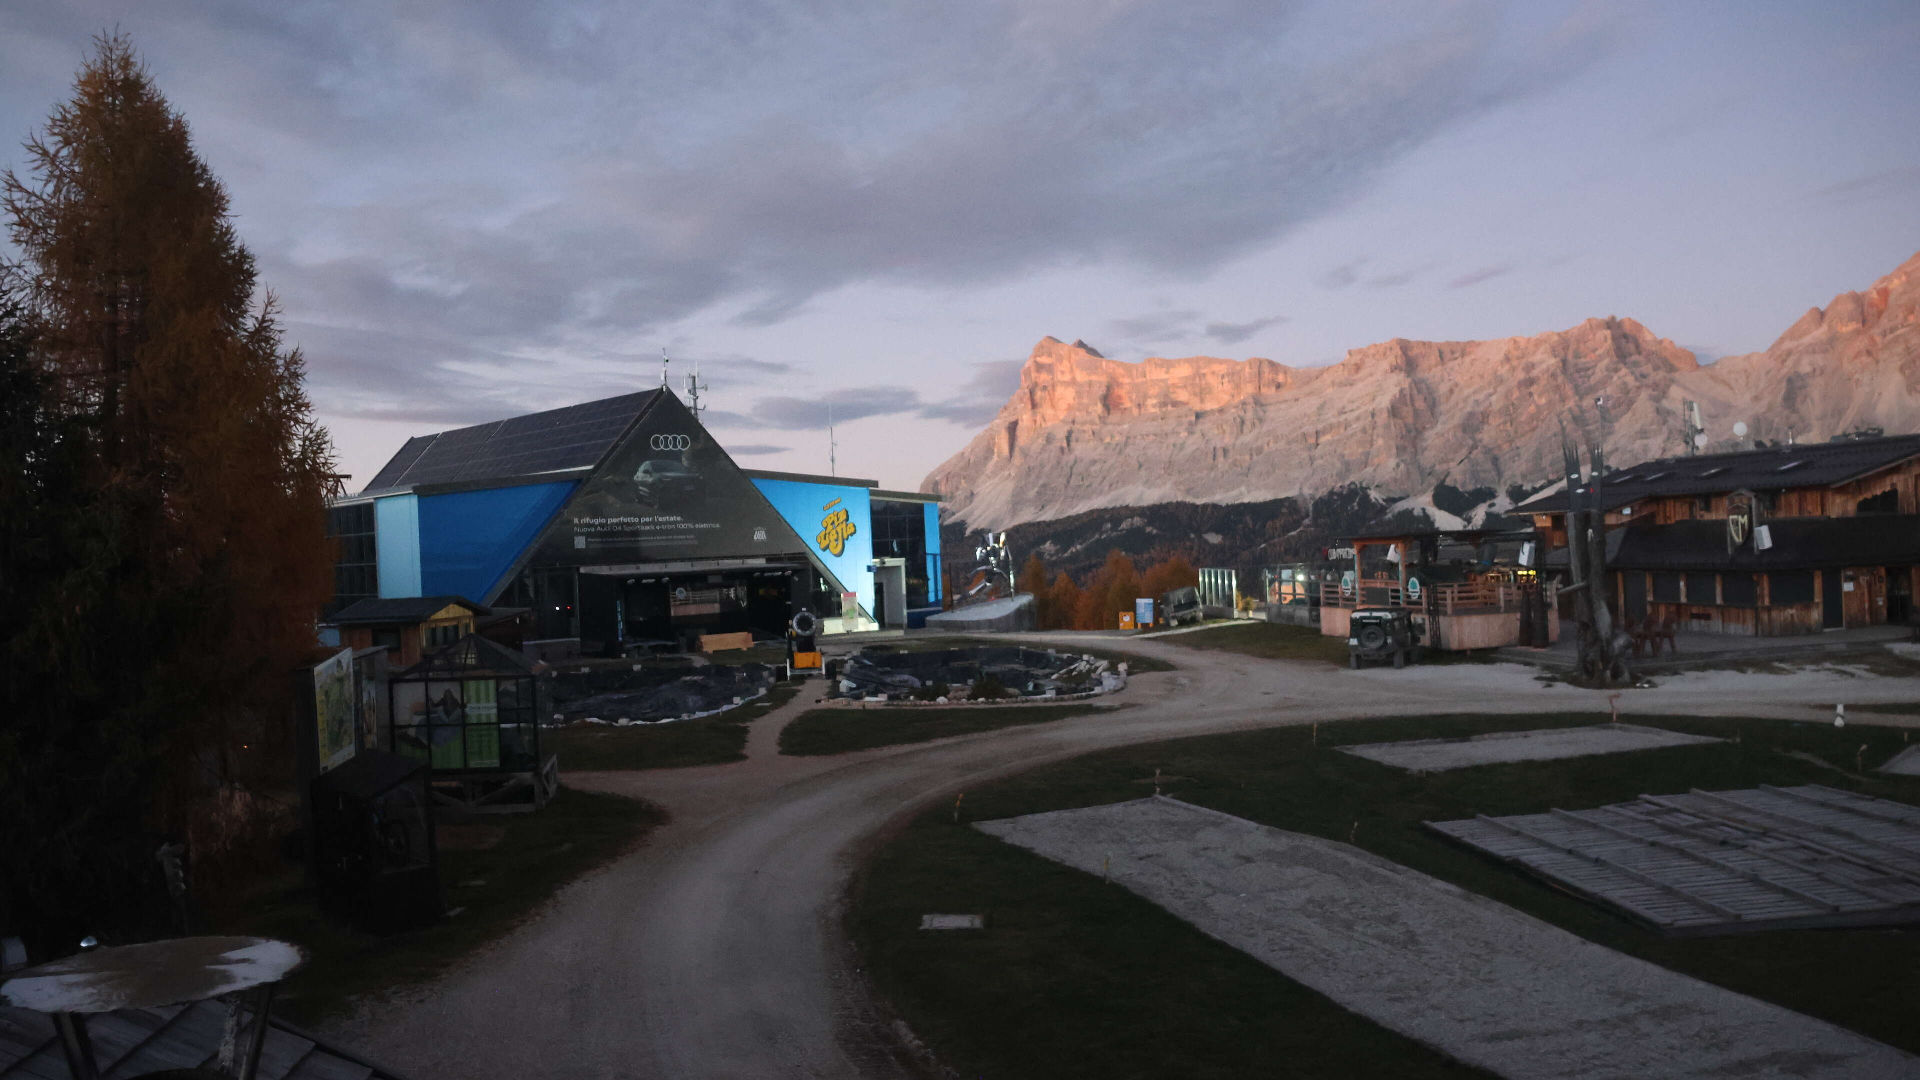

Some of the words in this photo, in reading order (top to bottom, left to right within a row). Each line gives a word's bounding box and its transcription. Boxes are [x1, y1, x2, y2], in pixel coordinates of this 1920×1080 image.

[580, 516, 606, 525] rifugio
[607, 516, 639, 525] perfetto
[640, 516, 653, 525] per
